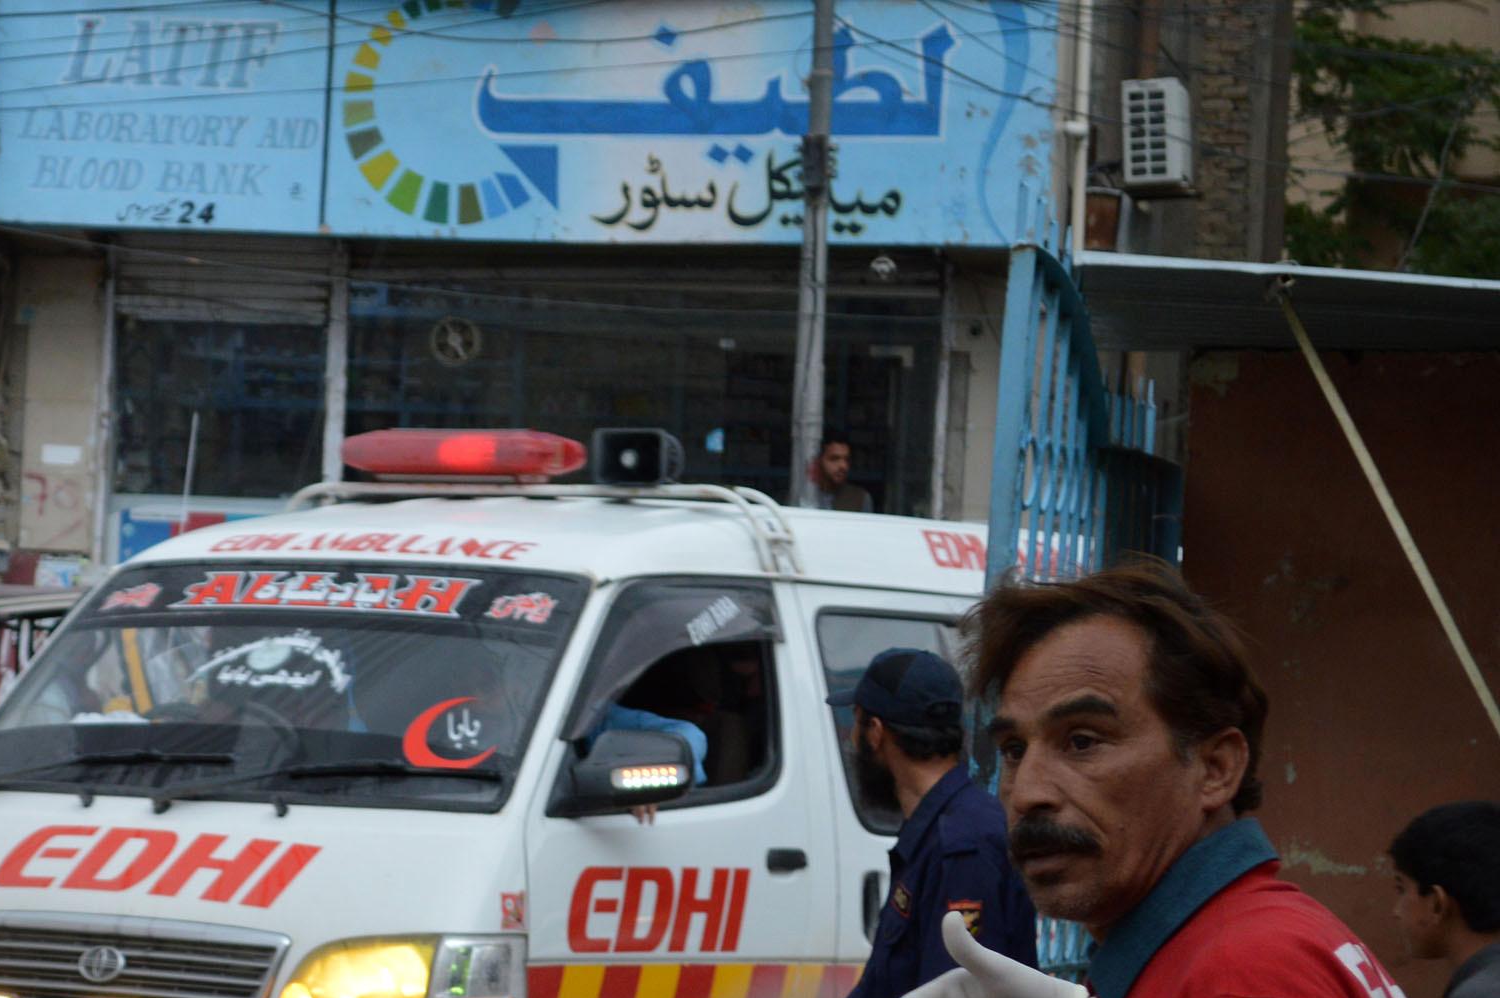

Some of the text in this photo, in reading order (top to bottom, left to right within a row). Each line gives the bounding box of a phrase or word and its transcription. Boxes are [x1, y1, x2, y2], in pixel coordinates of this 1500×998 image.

[62, 15, 280, 89] LATIF
[18, 109, 319, 149] LABORATORY AND
[29, 154, 144, 192] BLOOD
[156, 160, 270, 195] BANK
[178, 201, 216, 224] 24
[921, 529, 987, 571] EDH
[567, 866, 751, 953] EDHI
